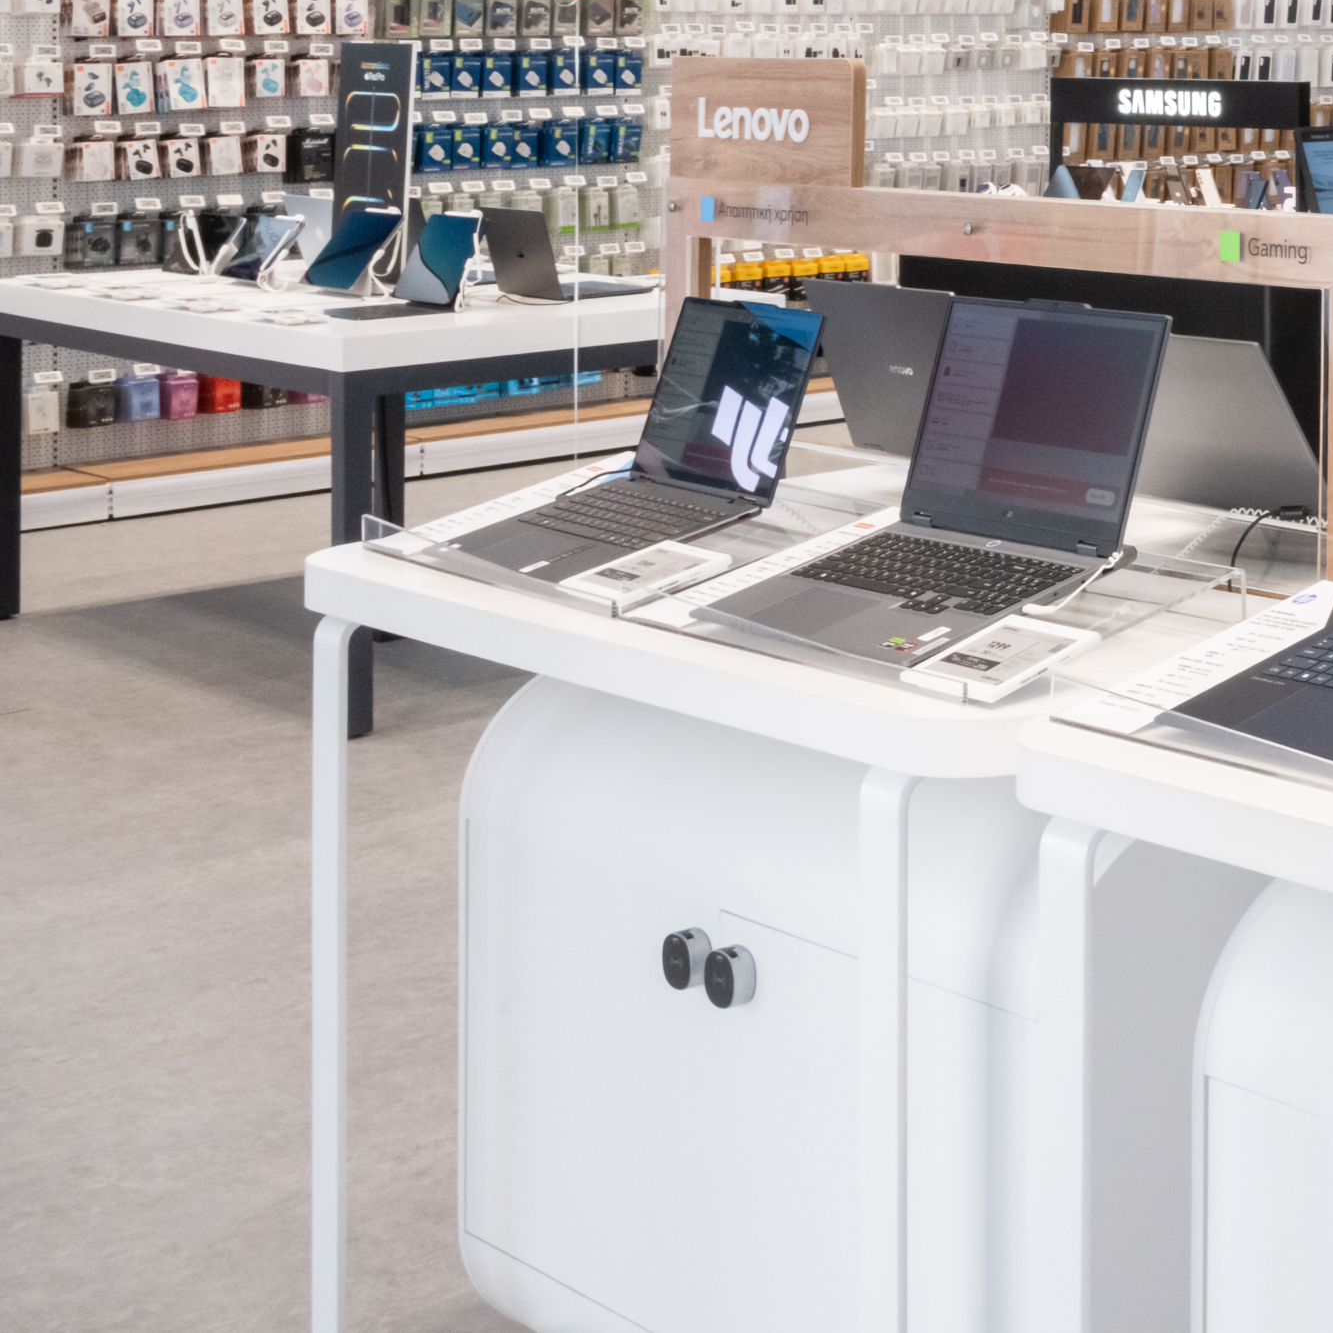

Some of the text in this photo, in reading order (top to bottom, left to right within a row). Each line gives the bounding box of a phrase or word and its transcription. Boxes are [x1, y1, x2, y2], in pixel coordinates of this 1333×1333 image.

[1118, 88, 1222, 117] SAMSUNG
[698, 97, 810, 143] Lenovo
[718, 201, 772, 223] Απαιτητική
[1247, 237, 1309, 265] Gaming
